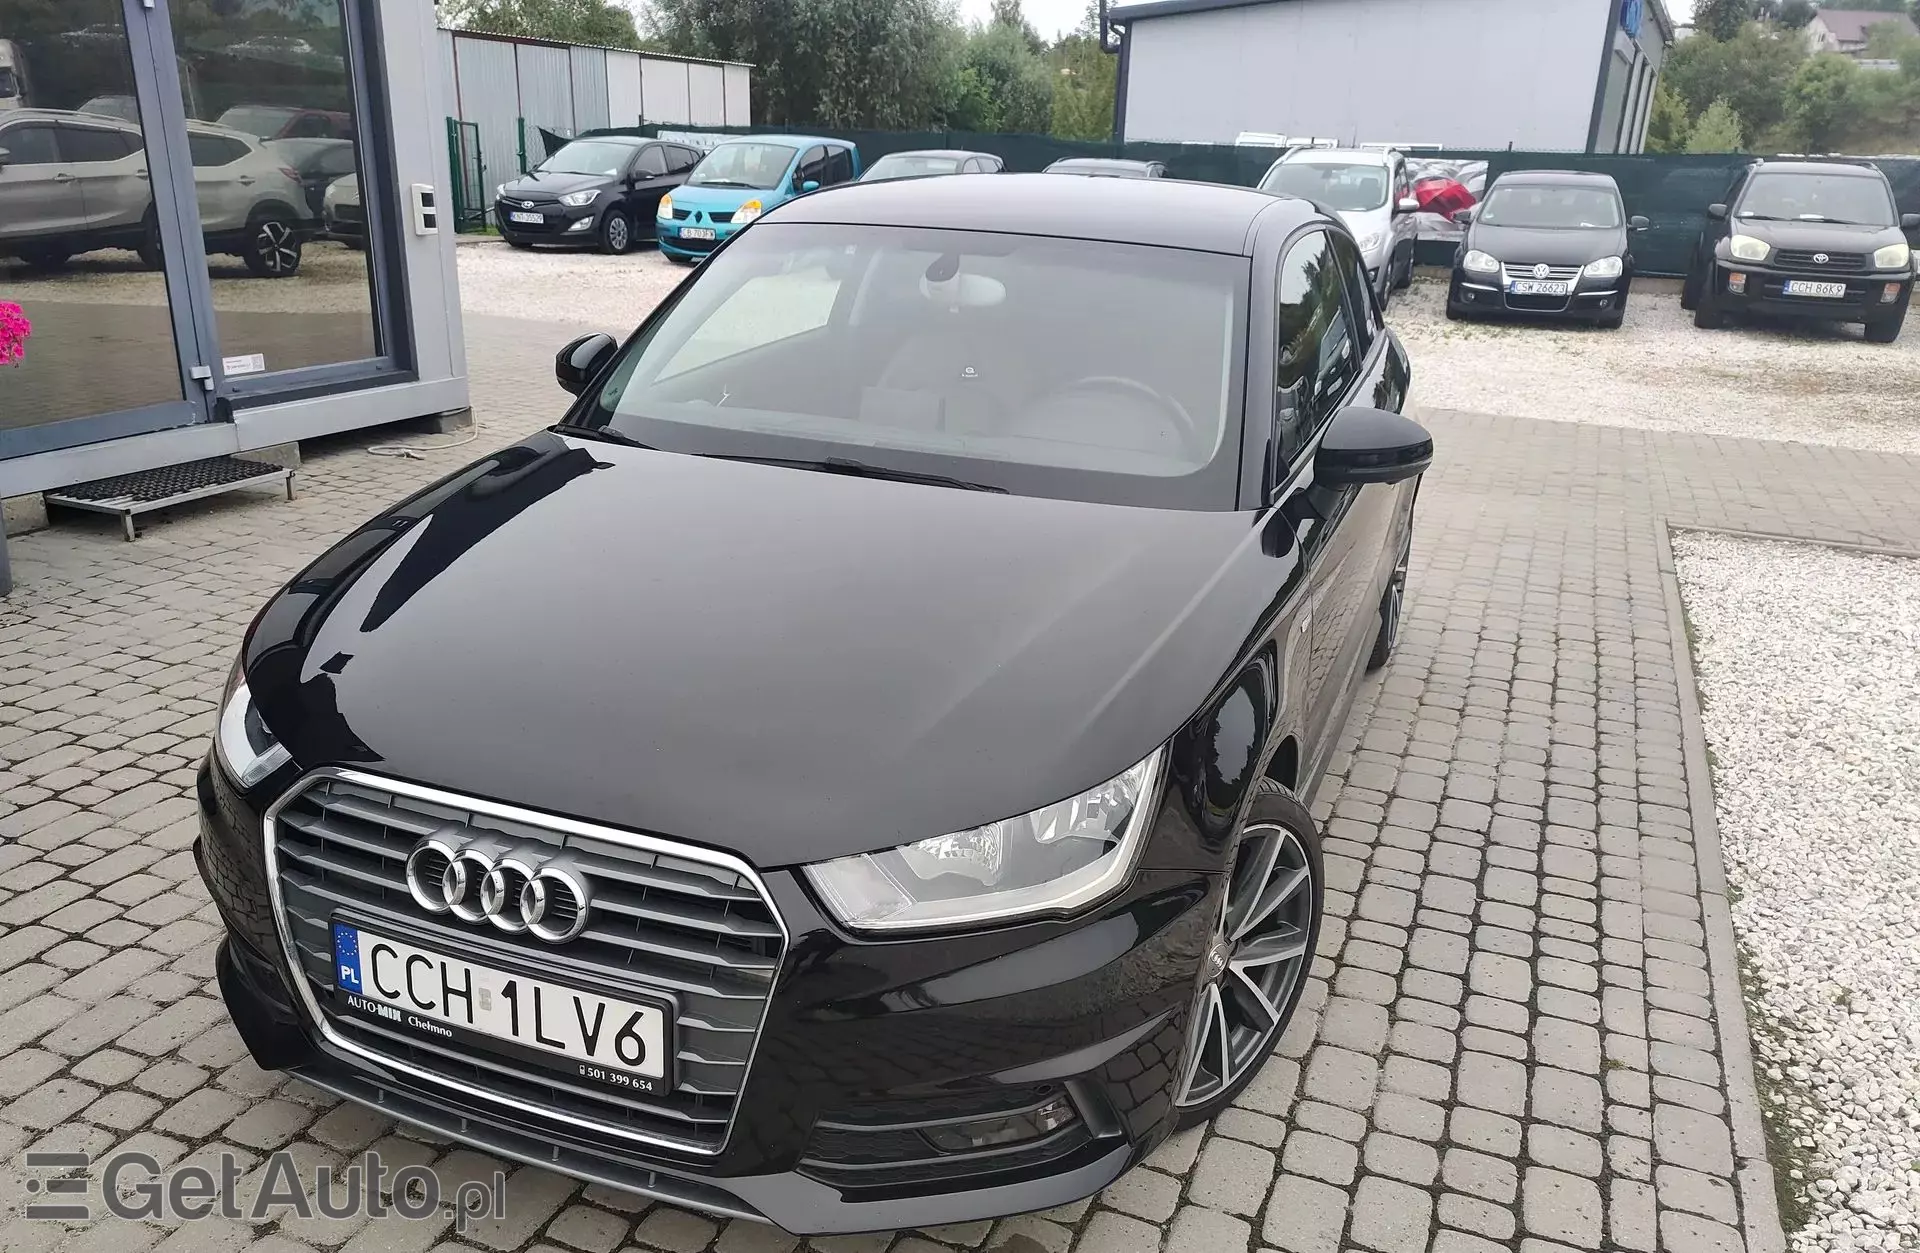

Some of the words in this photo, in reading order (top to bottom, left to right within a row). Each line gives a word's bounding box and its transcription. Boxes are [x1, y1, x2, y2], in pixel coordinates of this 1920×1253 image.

[1516, 282, 1534, 292] CSW
[1536, 283, 1566, 294] 26623
[1791, 282, 1813, 293] CCH
[1816, 283, 1843, 295] 86K9
[341, 965, 359, 984] PL
[371, 943, 473, 1024] CCH
[501, 980, 646, 1067] 1LV6
[408, 1016, 452, 1037] Chełmno
[587, 1067, 606, 1080] 501
[610, 1073, 630, 1086] 399
[632, 1079, 653, 1091] 654
